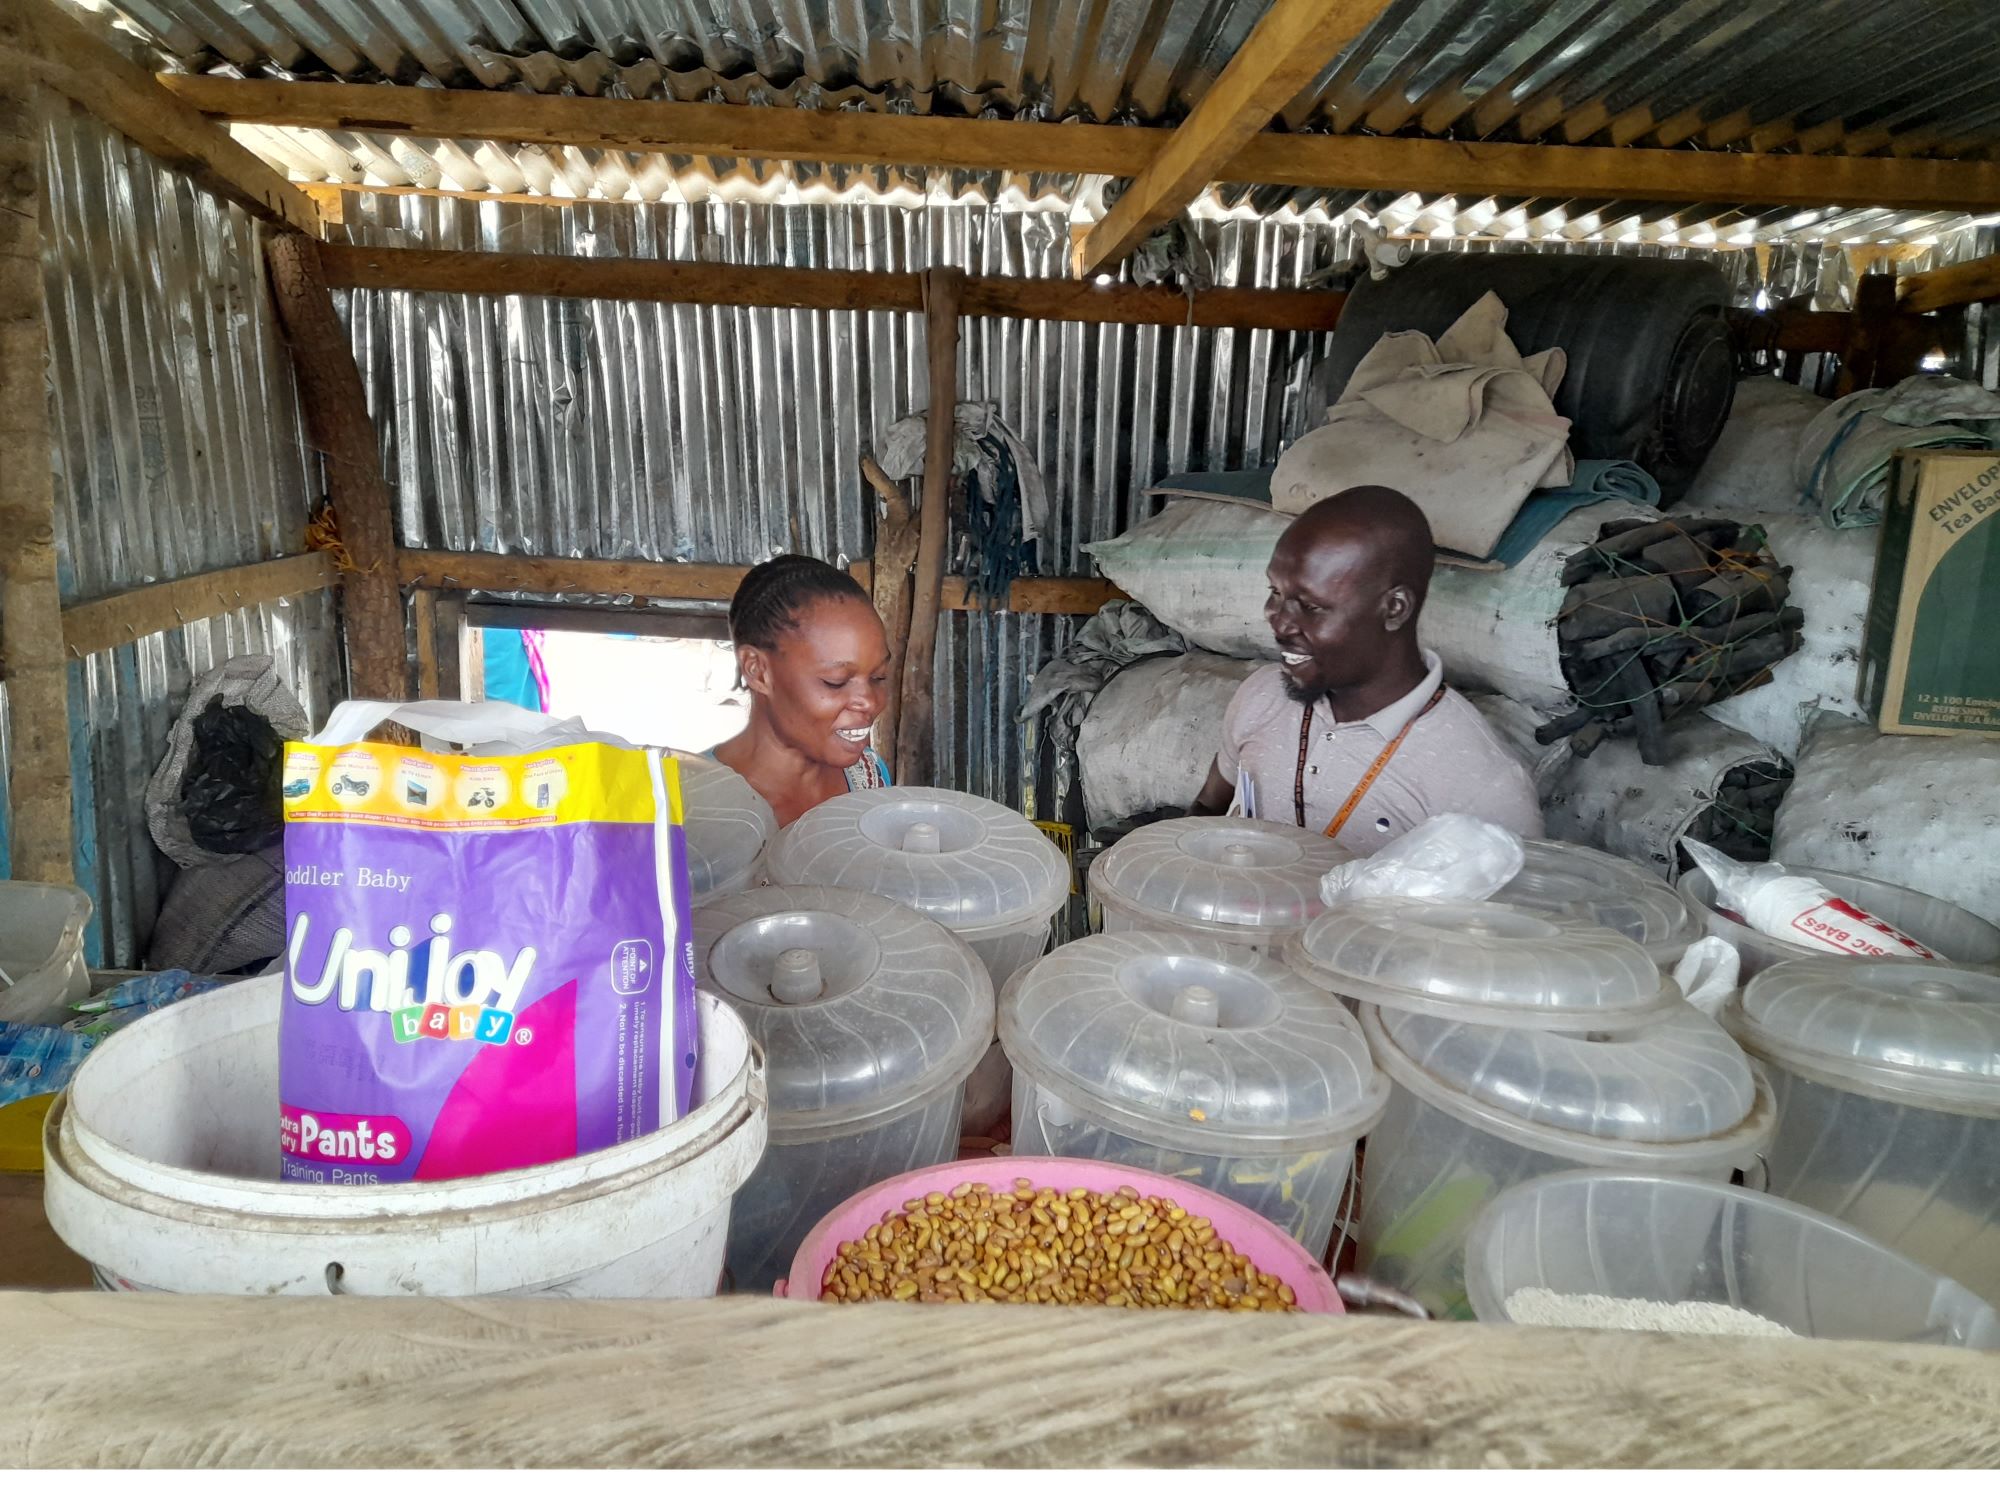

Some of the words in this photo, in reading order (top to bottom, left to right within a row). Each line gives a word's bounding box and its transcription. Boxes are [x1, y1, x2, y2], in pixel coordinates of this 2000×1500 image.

[1929, 461, 2000, 521] ENVELOP
[1941, 513, 1973, 534] Tea
[1918, 694, 1931, 703] 12
[1943, 696, 1963, 705] 100
[285, 864, 344, 886] oddler
[357, 867, 412, 892] Baby
[1804, 917, 1851, 942] BAGS
[289, 911, 537, 1012] Unijoy
[630, 973, 636, 985] OF
[400, 1009, 507, 1039] baby
[640, 1010, 646, 1020] To
[619, 1032, 626, 1042] to
[619, 1043, 626, 1056] be
[617, 1105, 624, 1114] in
[280, 1115, 299, 1134] xtra
[281, 1132, 297, 1153] dry
[300, 1114, 396, 1160] Pants
[282, 1156, 324, 1185] Training
[332, 1168, 378, 1185] Pants
